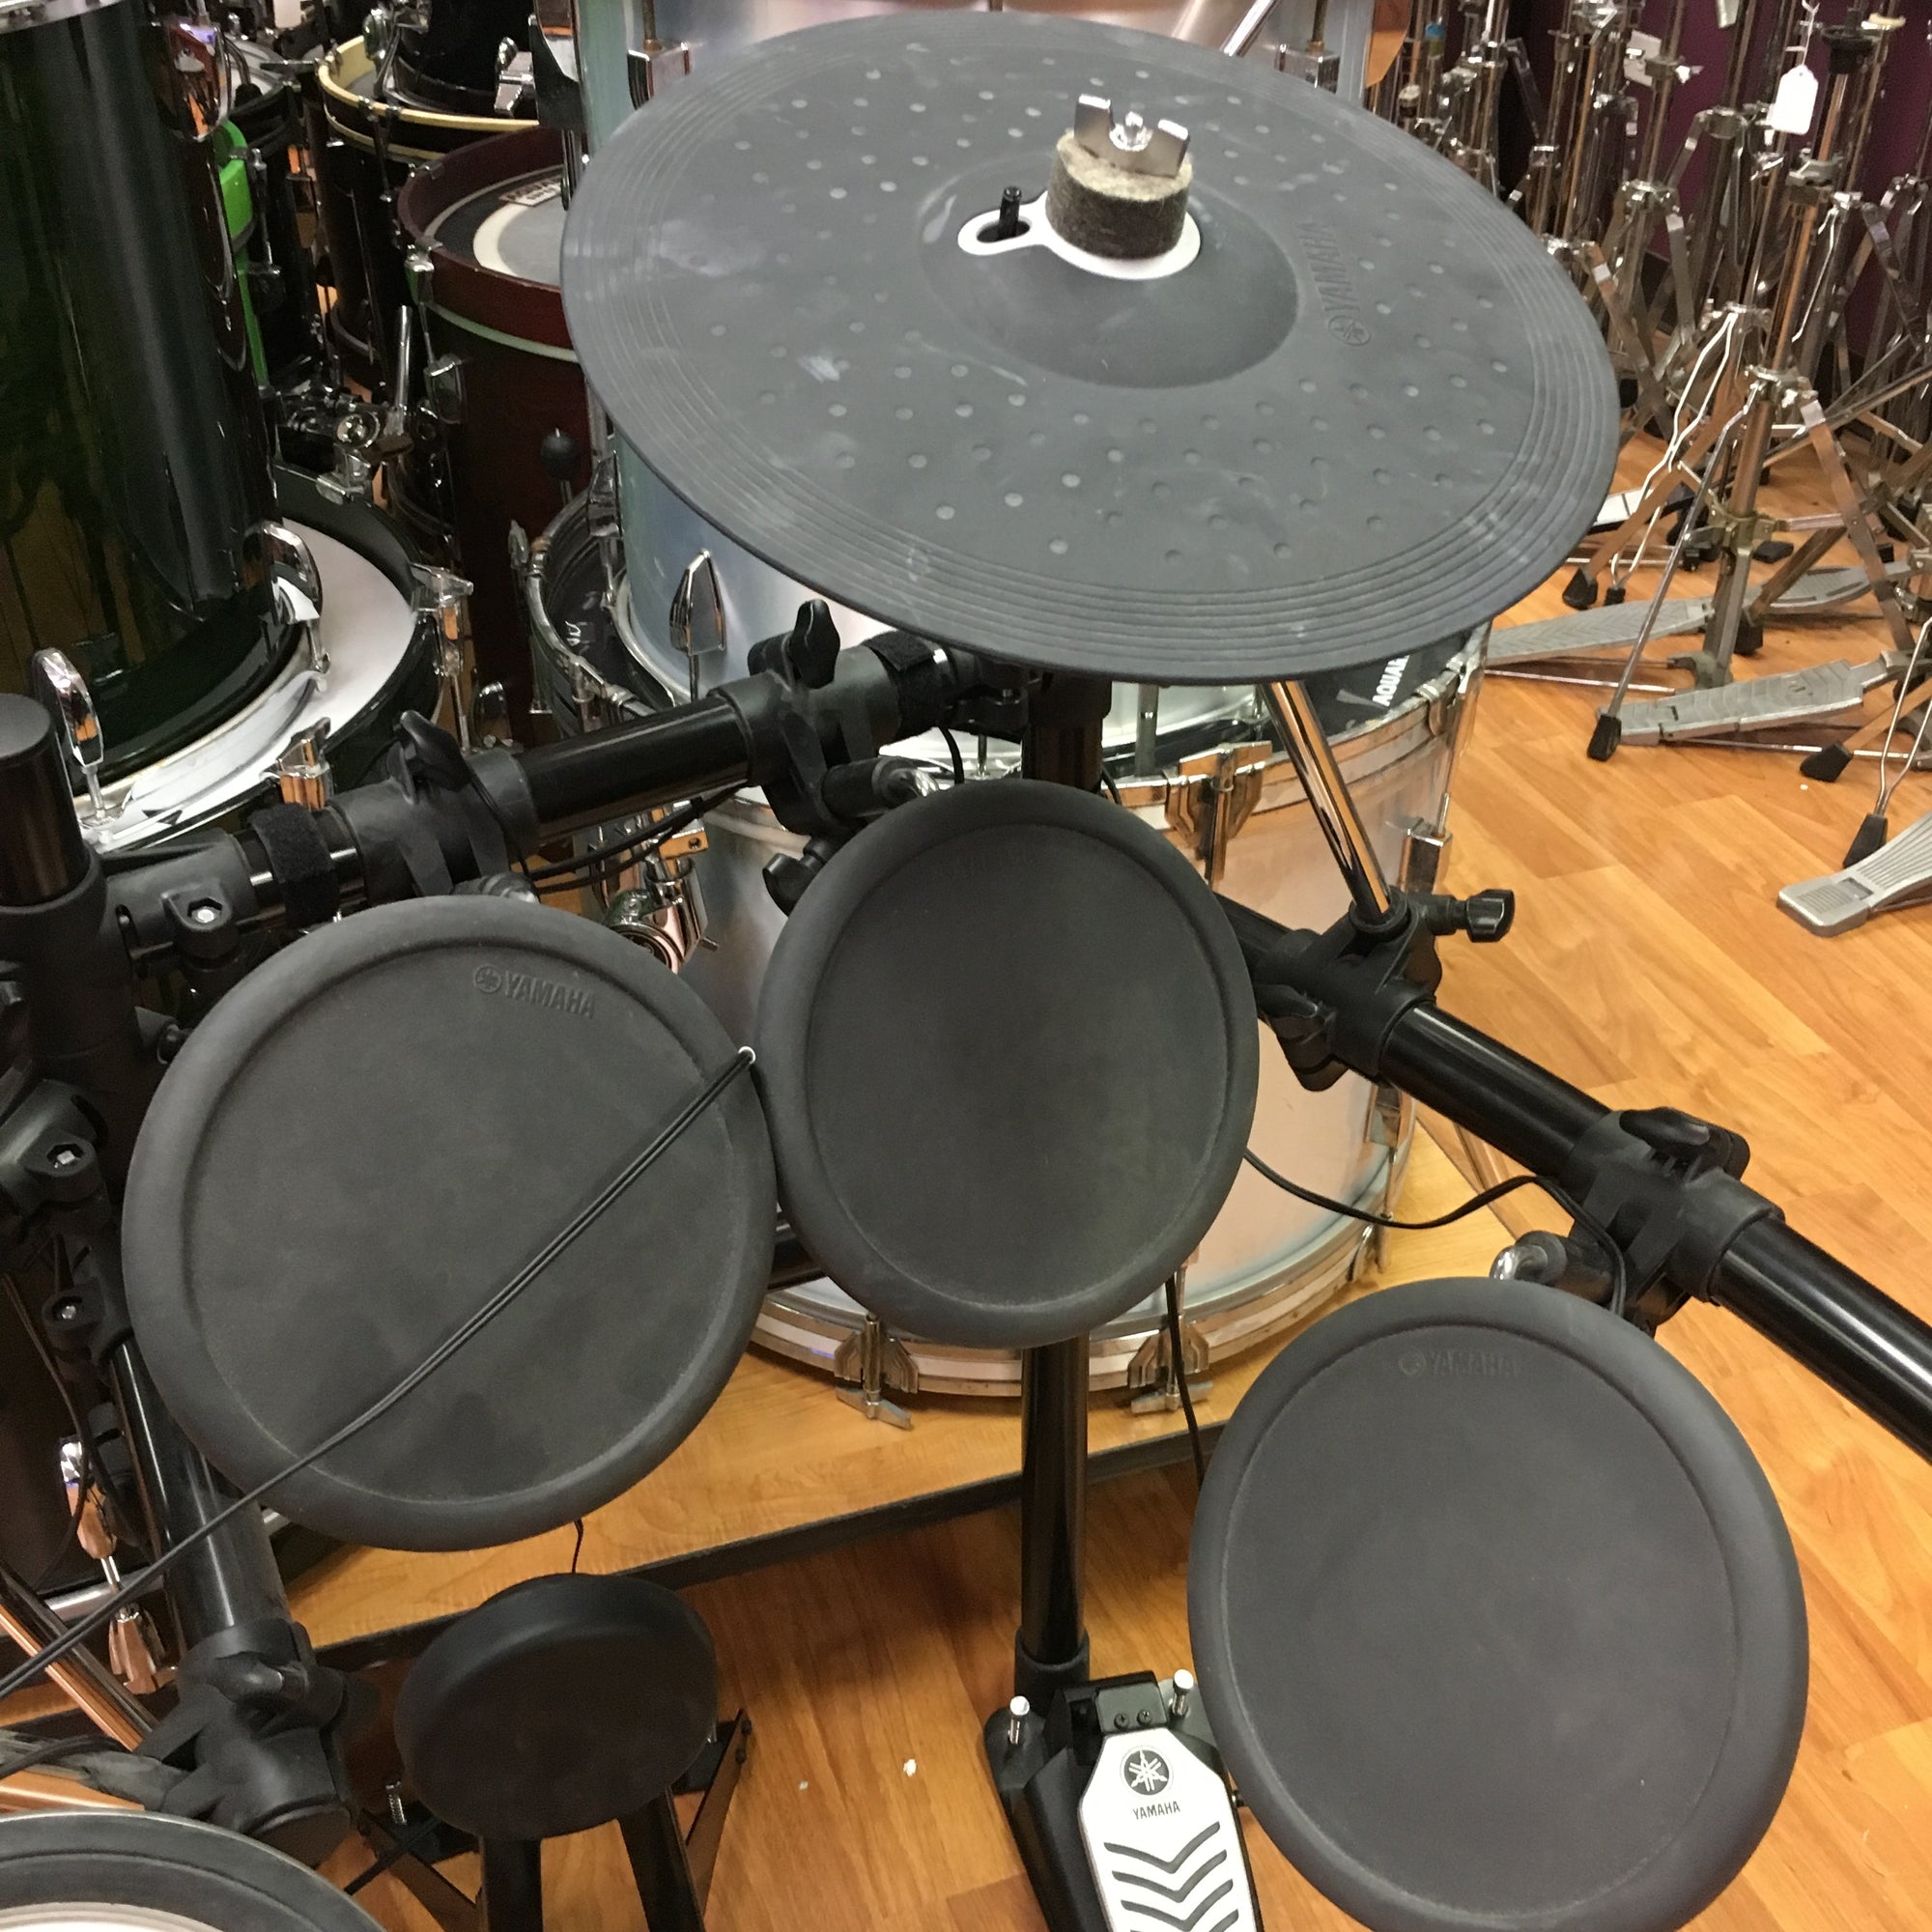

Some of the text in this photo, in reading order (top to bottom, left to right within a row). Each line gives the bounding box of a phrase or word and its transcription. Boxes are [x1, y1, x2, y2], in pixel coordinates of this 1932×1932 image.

[1295, 222, 1360, 311] YAMAHA
[503, 970, 595, 1020] YAMAHA
[1428, 1350, 1518, 1378] YAMAHA
[1131, 1801, 1180, 1821] YAMAHA
